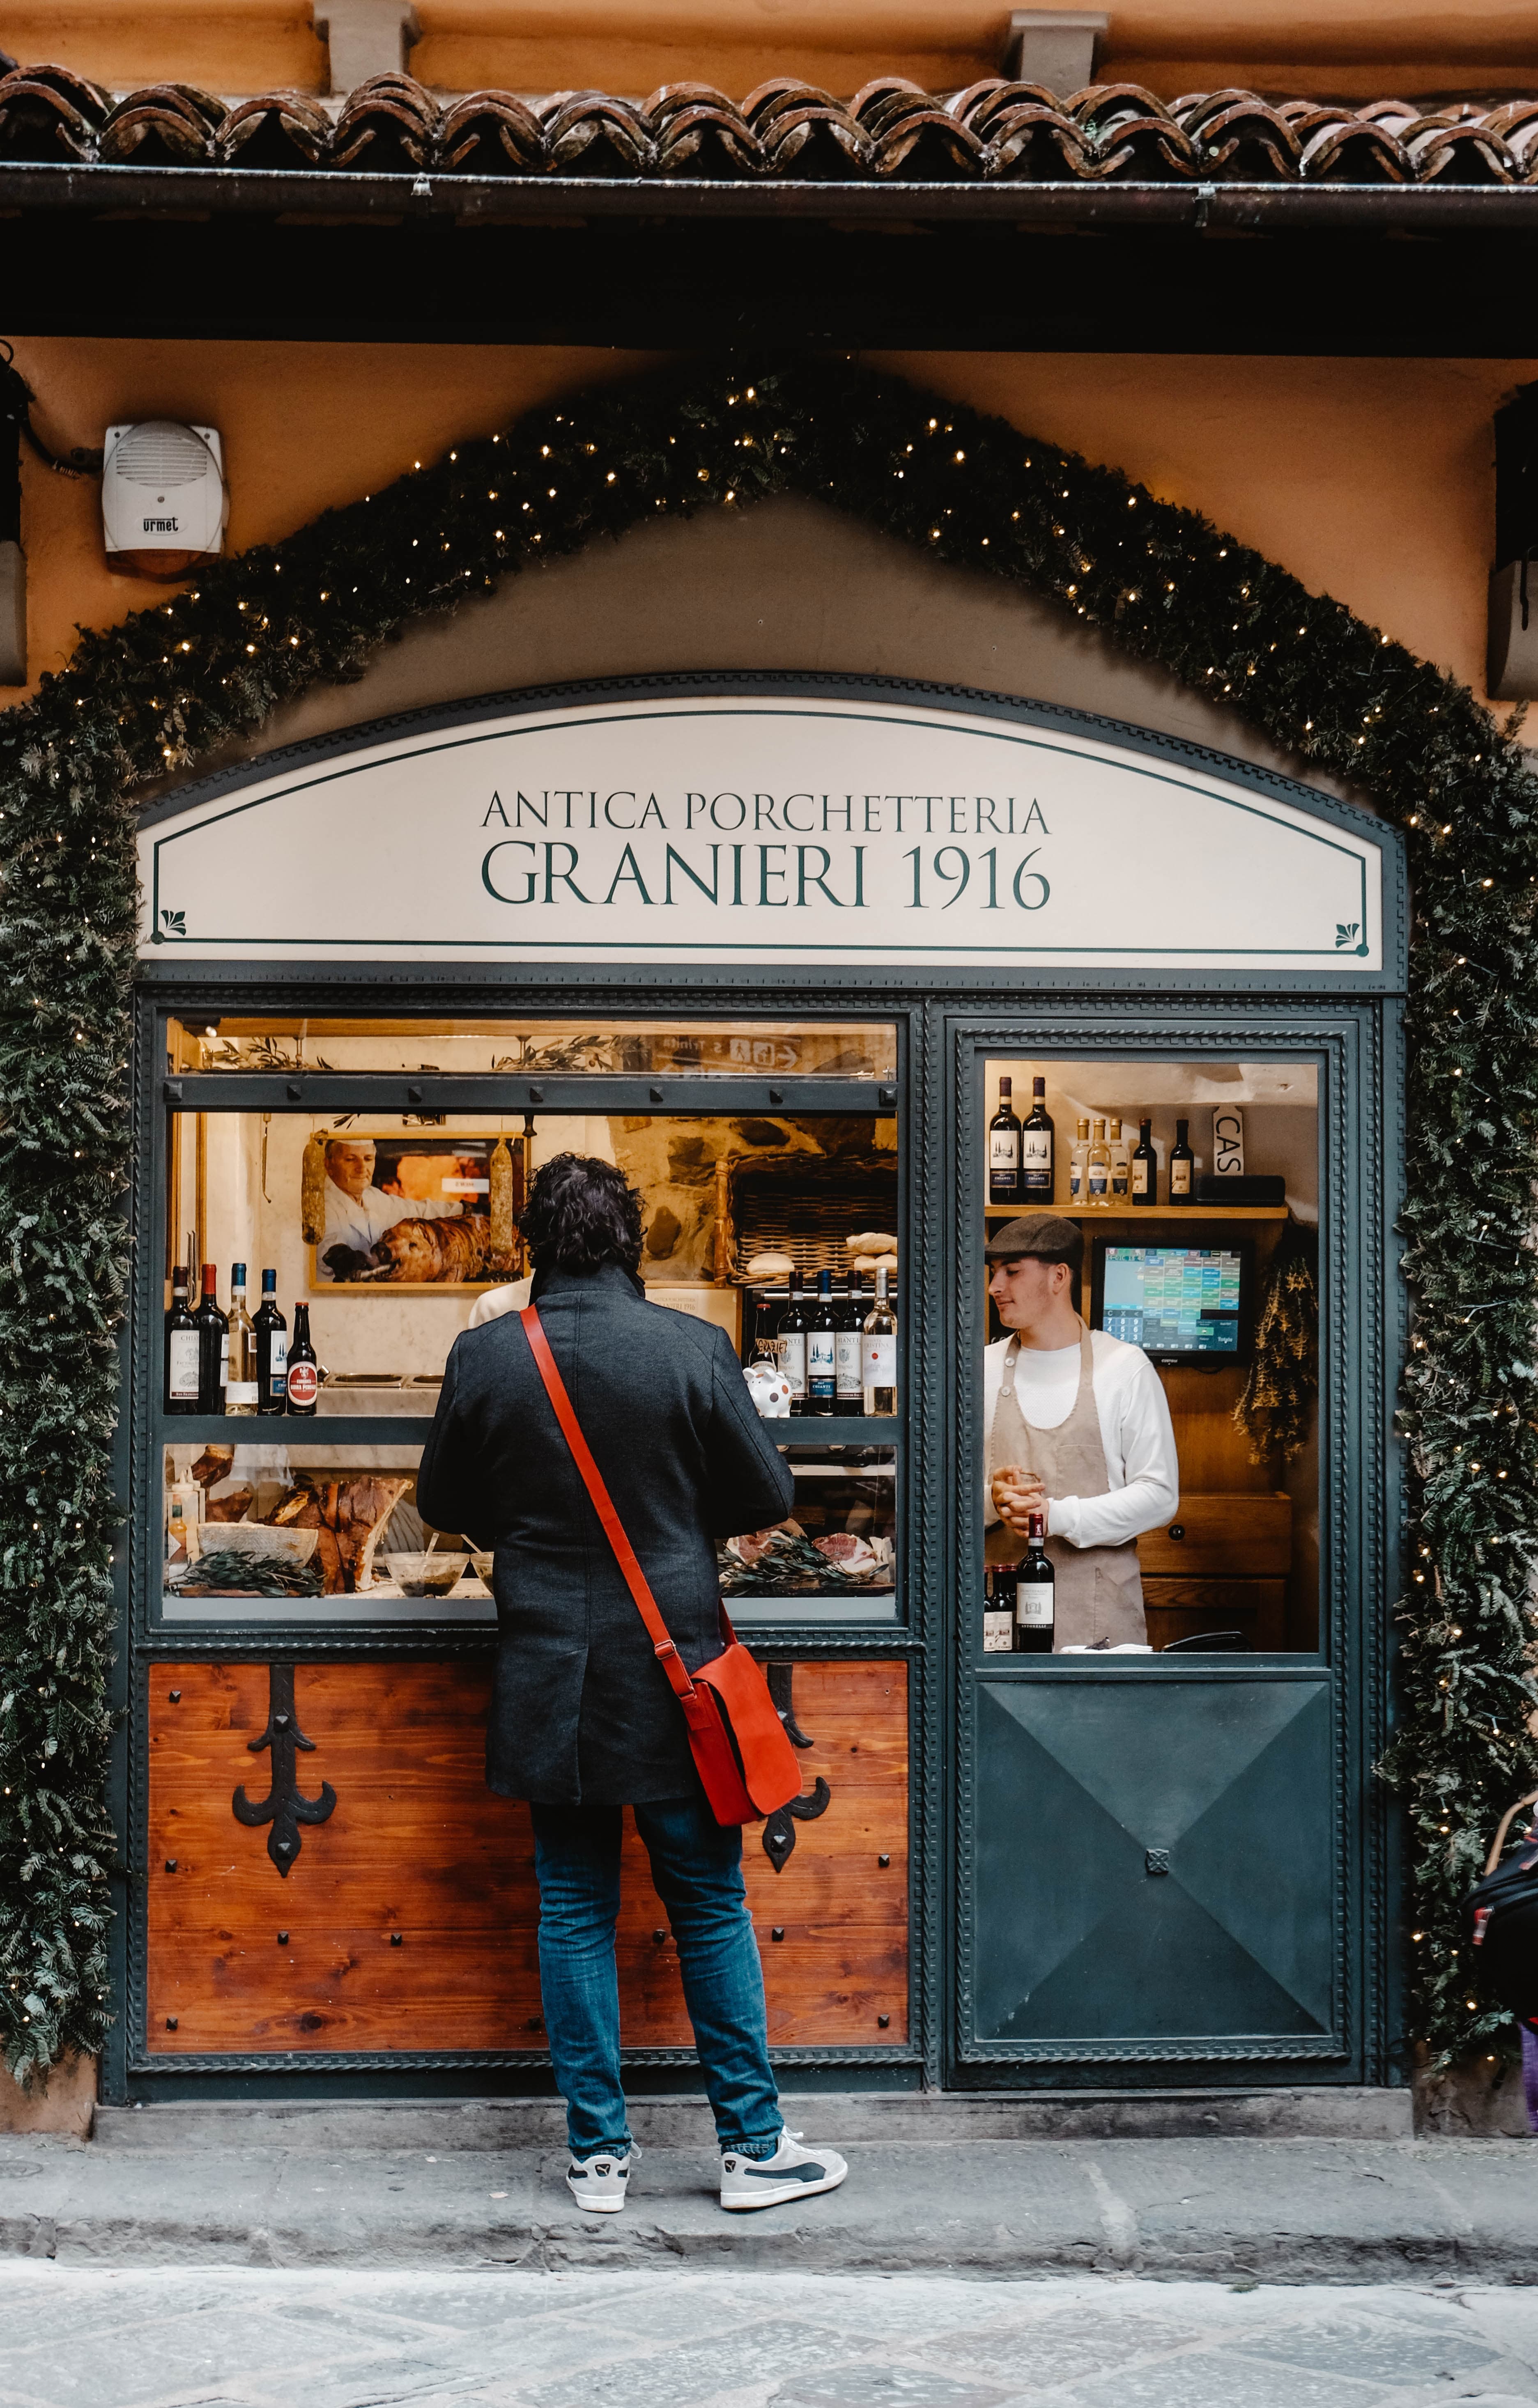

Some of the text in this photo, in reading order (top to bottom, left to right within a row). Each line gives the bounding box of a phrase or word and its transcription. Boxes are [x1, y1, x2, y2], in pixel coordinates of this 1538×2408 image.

[144, 517, 178, 531] urmet
[479, 790, 1052, 835] ANTICA PORCHETTERIA
[481, 840, 1051, 910] GRANIERI 1916
[1216, 1116, 1241, 1172] CAS
